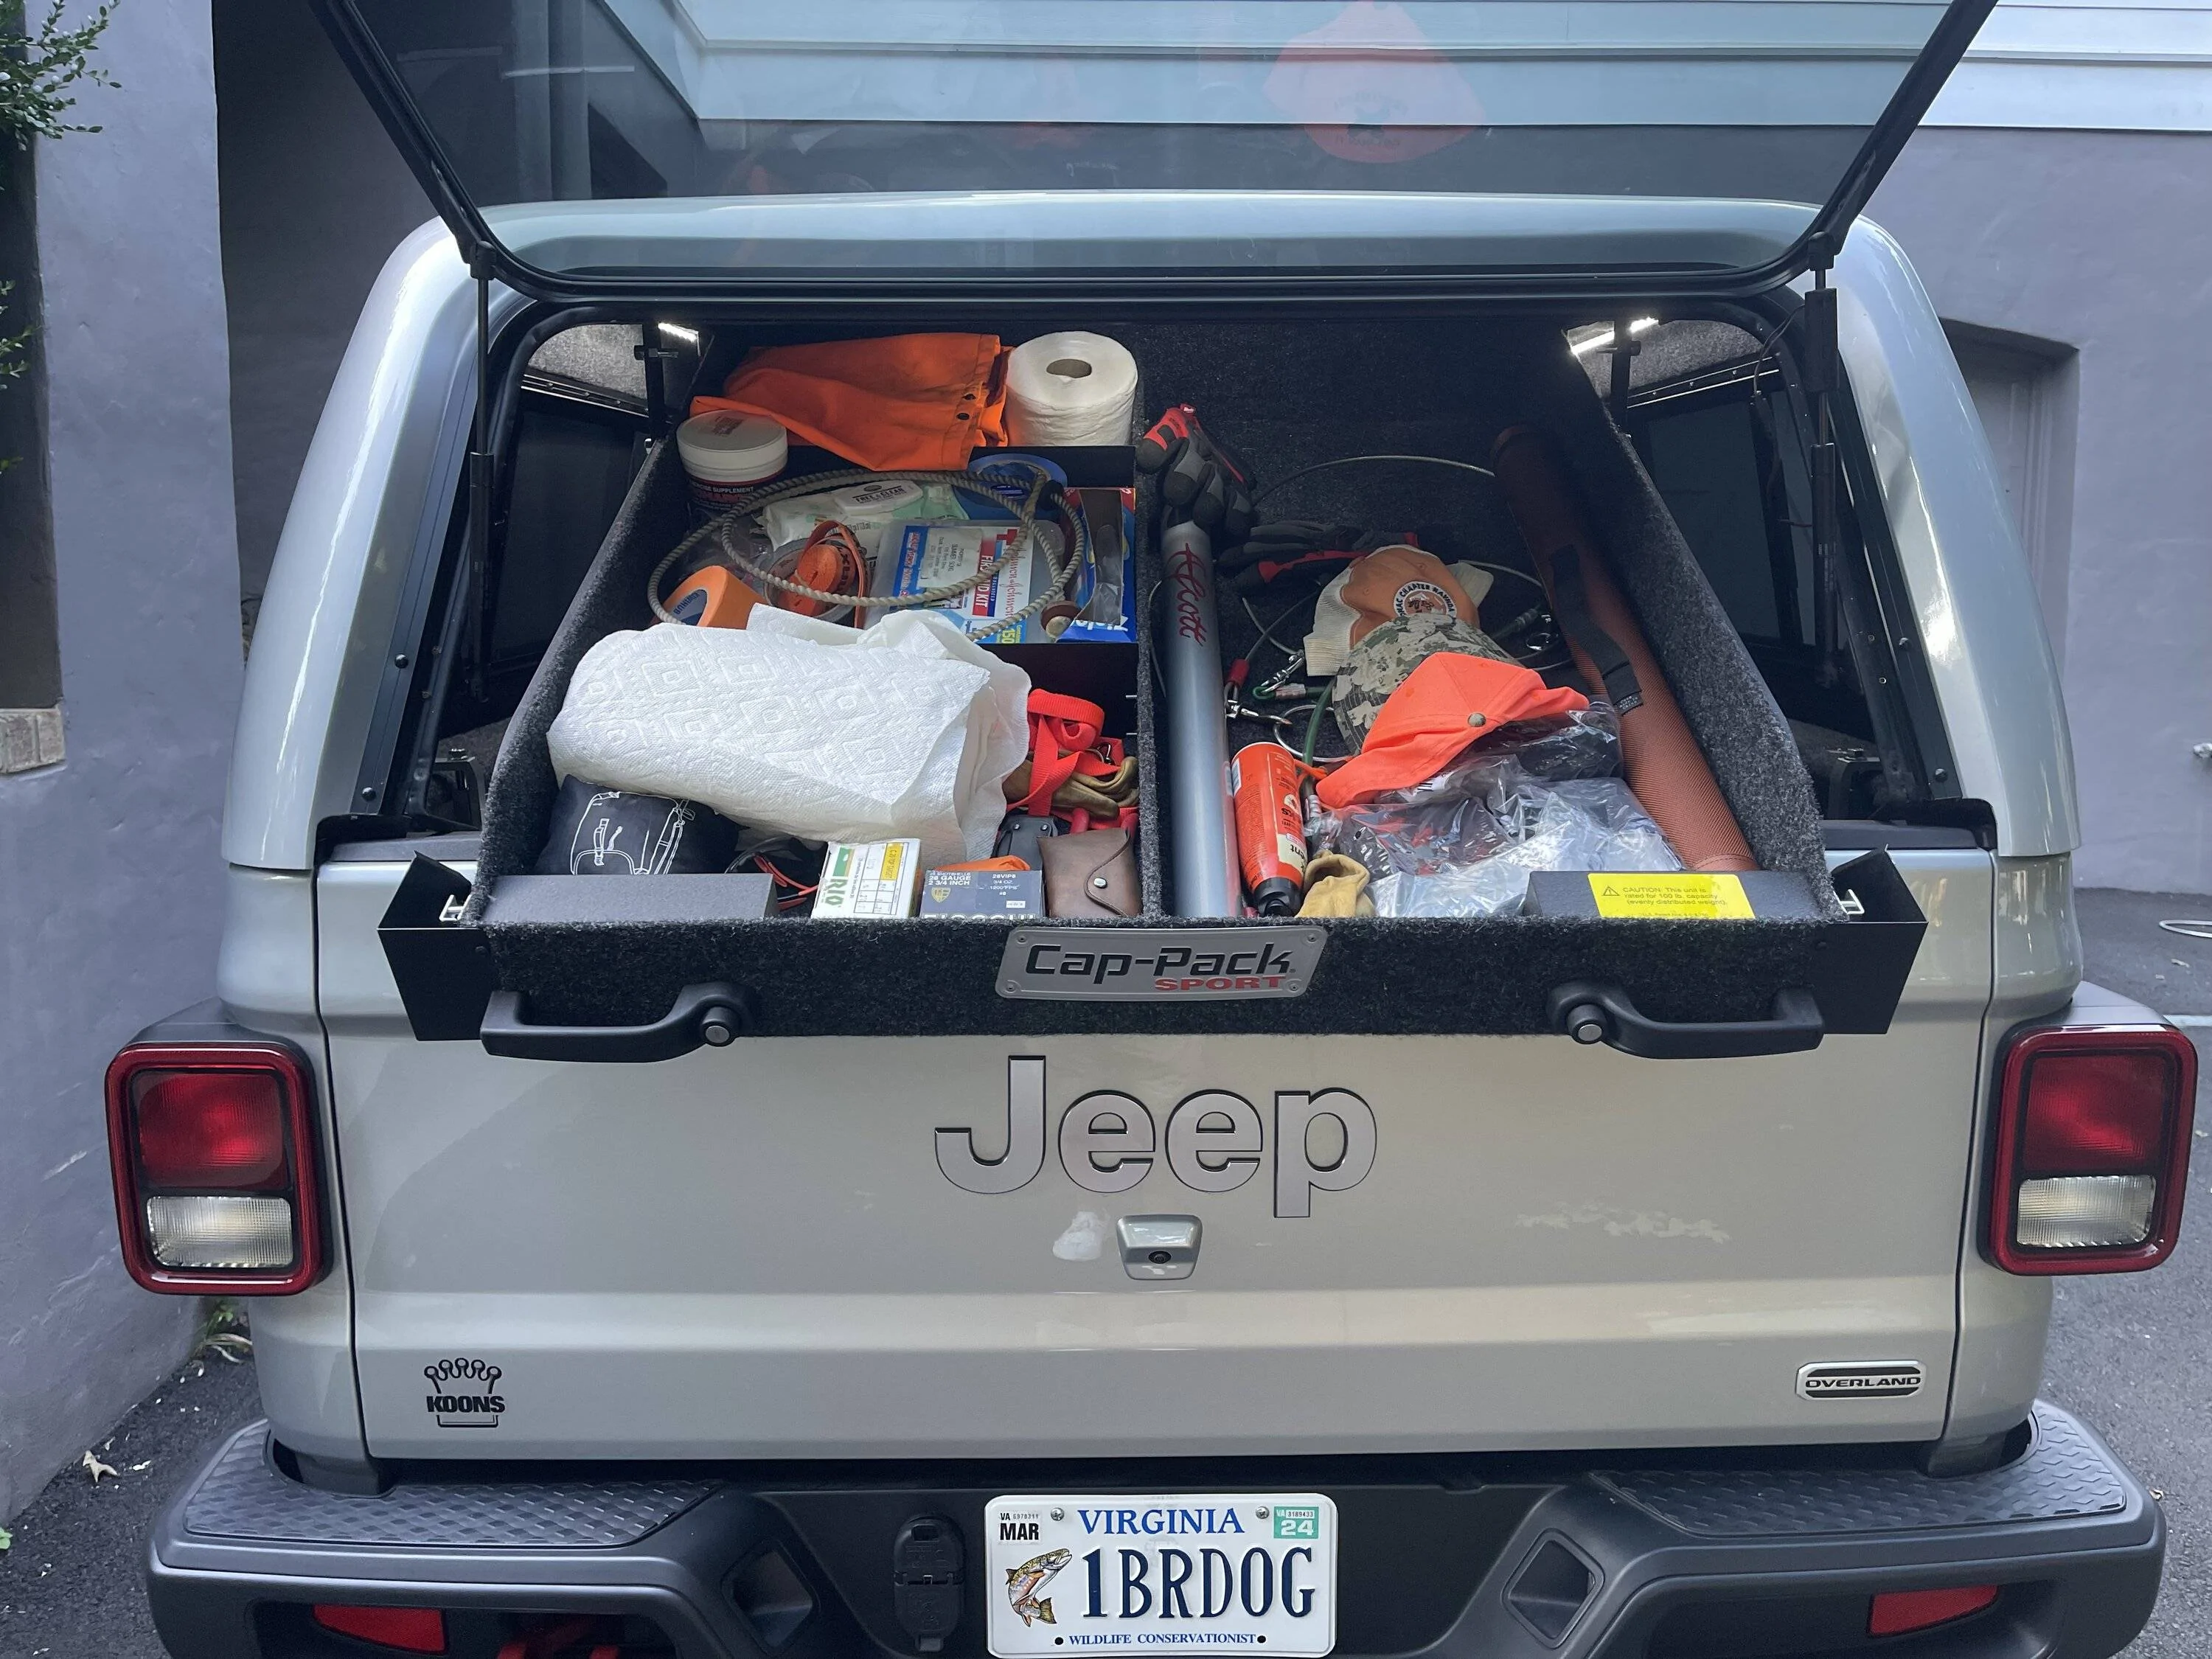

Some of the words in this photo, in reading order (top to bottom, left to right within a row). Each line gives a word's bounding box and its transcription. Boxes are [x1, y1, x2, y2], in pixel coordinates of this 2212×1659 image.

[1399, 582, 1430, 597] CHAPTER
[975, 594, 989, 608] KIT
[1001, 628, 1015, 644] 150
[824, 879, 849, 905] RIO
[1026, 942, 1293, 984] Cap-Pack
[1154, 975, 1286, 991] SPORT
[934, 1054, 1377, 1217] Jeep
[1805, 1377, 1921, 1388] OVERLAND
[426, 1395, 506, 1413] KOONS
[1000, 1512, 1011, 1520] VA
[1077, 1508, 1245, 1534] VIRGINIA
[1000, 1523, 1039, 1540] MAR
[1281, 1519, 1314, 1536] 24
[1082, 1547, 1315, 1618] 1BRDOG
[1069, 1634, 1132, 1645] WILDLIFE
[1138, 1633, 1257, 1644] CONSERVATIONIST
